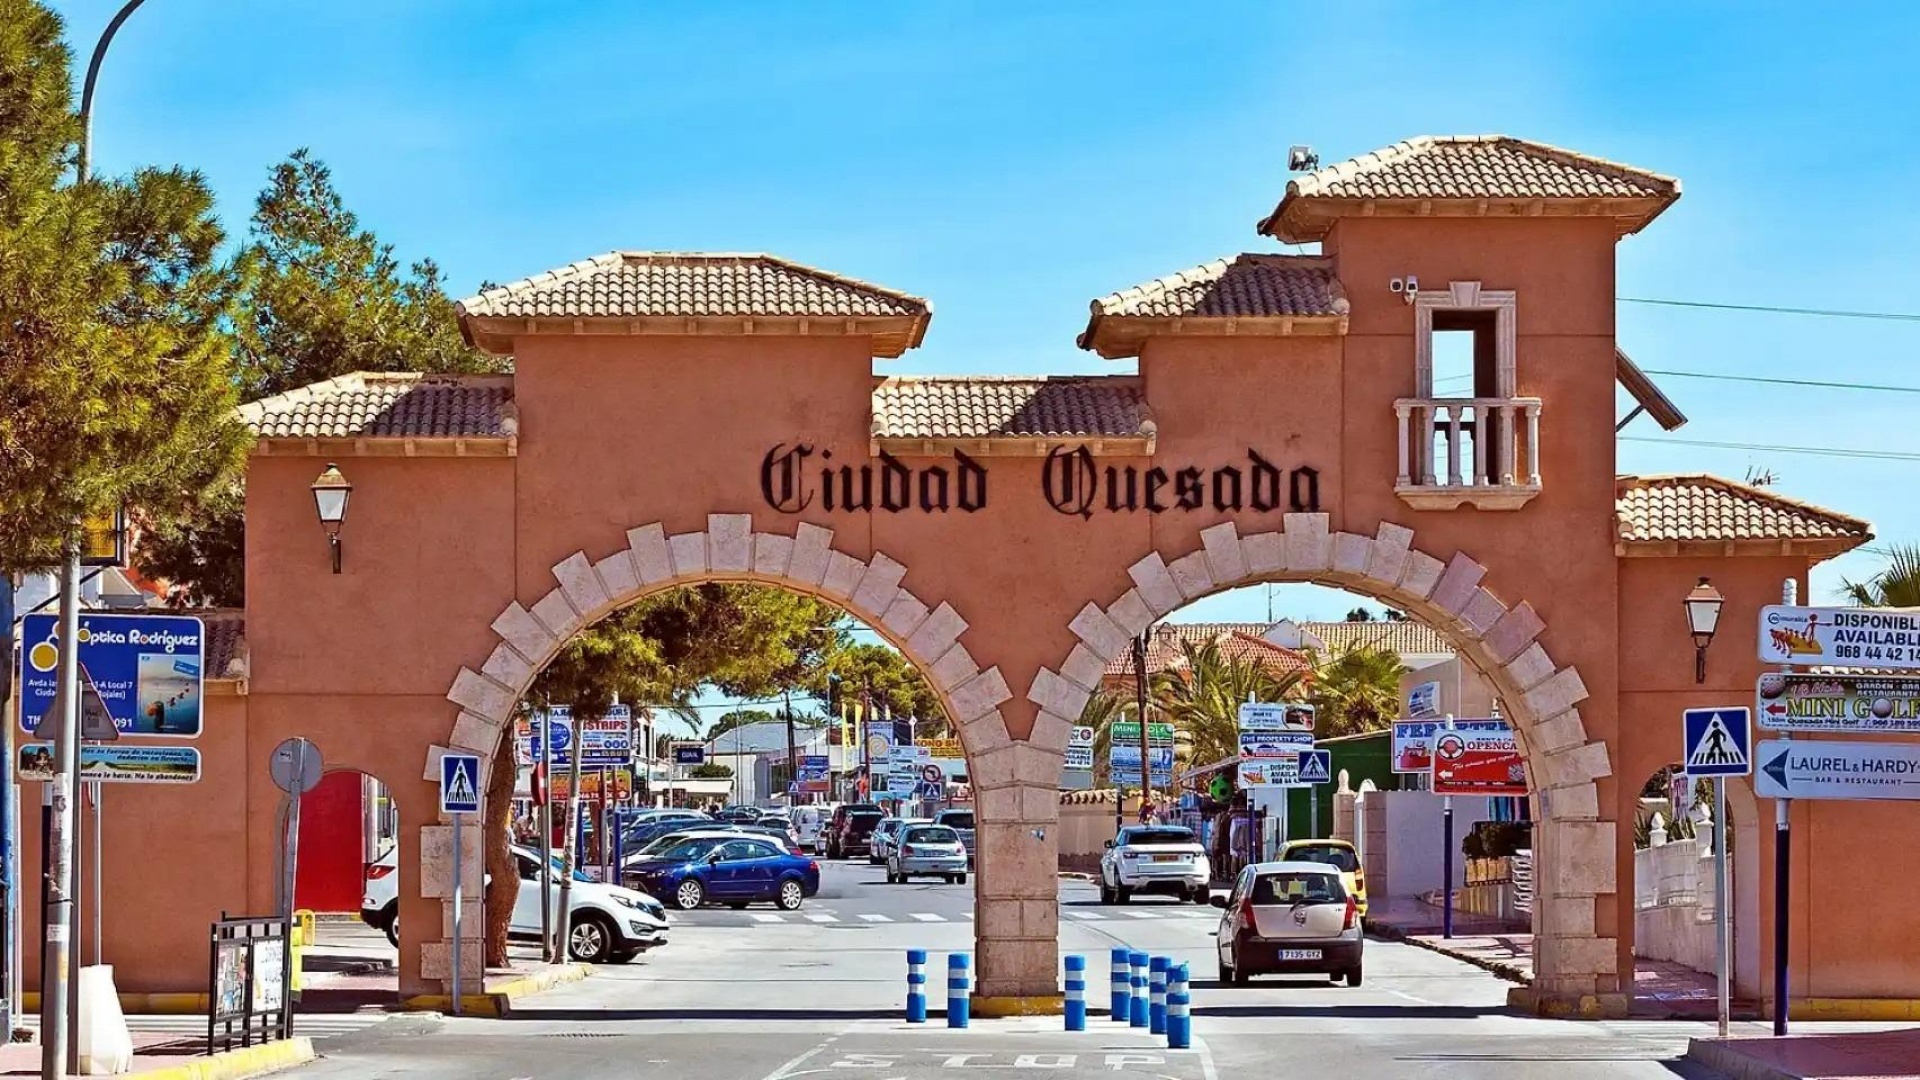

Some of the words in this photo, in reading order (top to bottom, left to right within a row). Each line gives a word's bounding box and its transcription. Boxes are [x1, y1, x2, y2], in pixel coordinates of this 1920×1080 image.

[761, 442, 989, 514] Ciudad
[1041, 443, 1322, 521] Quesada
[1834, 613, 1920, 630] DISPONIBL
[129, 629, 199, 653] Rodríguez
[1834, 630, 1920, 646] AVAILABL
[1836, 645, 1860, 658] 968
[1865, 646, 1881, 659] 44
[1886, 647, 1903, 660] 42
[35, 689, 57, 697] Ciuda
[1786, 696, 1846, 717] MINI
[1467, 741, 1518, 750] OPENCA
[1791, 756, 1850, 772] LAUREL
[1852, 763, 1860, 772] &
[1861, 758, 1920, 774] HARDY
[1845, 777, 1902, 785] RESTAURANT
[830, 1053, 1166, 1071] STOP
